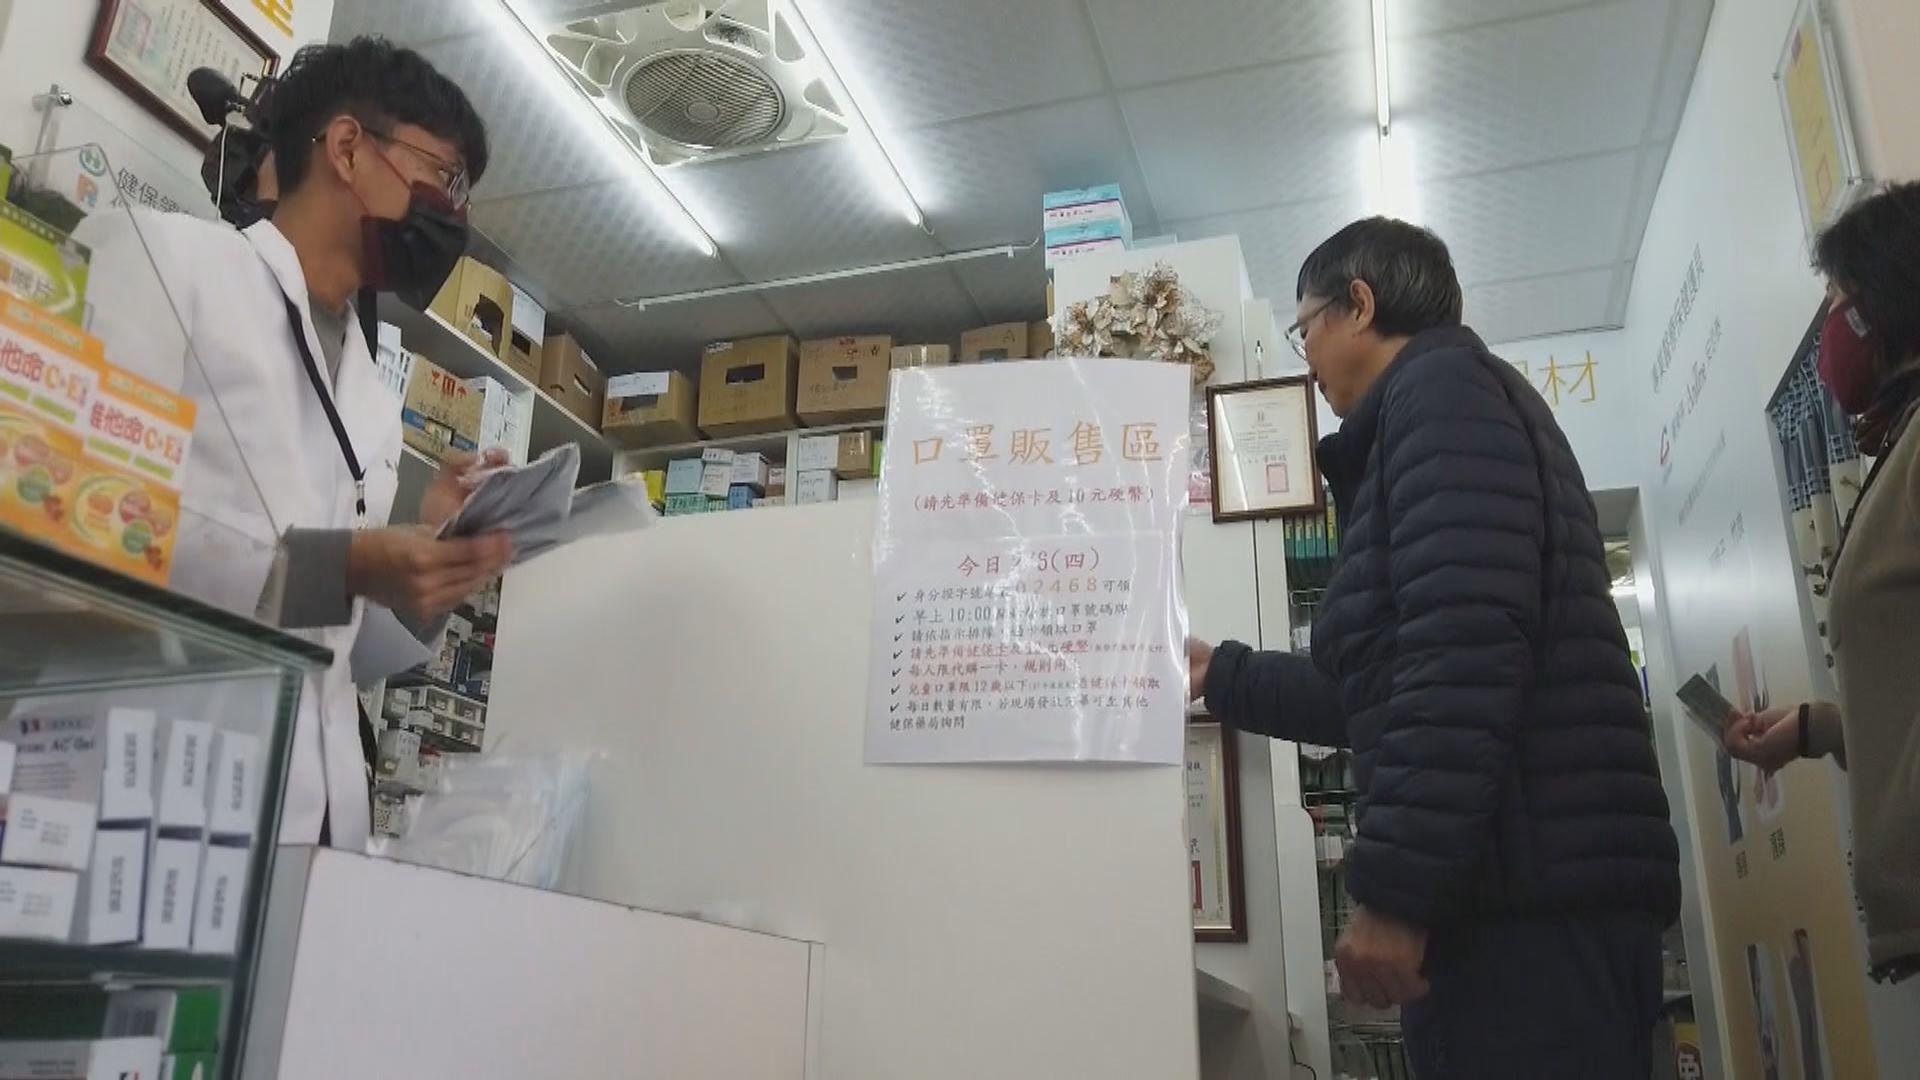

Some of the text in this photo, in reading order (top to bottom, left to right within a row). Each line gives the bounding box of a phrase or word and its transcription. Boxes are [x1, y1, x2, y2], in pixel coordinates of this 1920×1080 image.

[911, 420, 1164, 466] 口罩販售區
